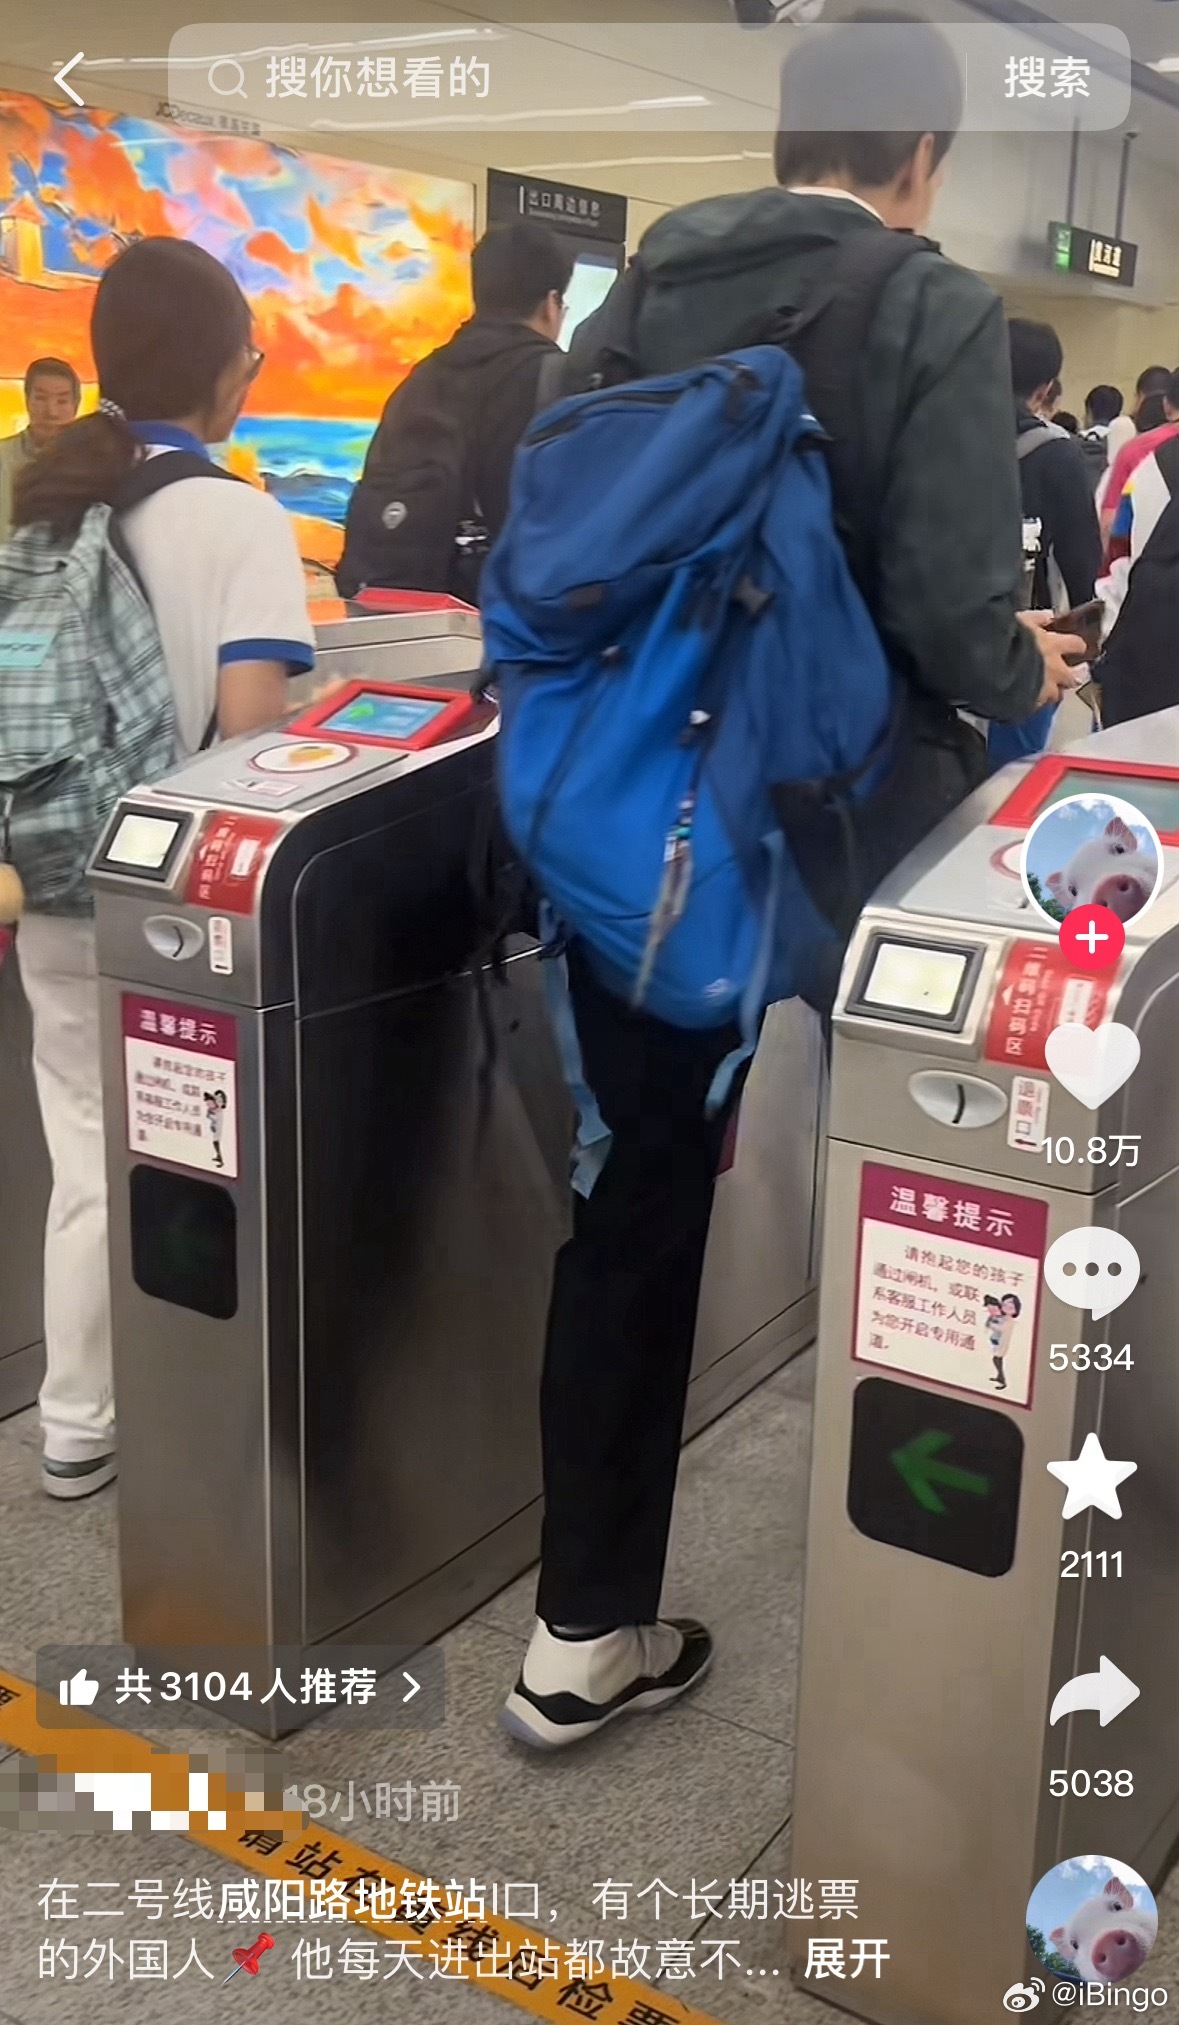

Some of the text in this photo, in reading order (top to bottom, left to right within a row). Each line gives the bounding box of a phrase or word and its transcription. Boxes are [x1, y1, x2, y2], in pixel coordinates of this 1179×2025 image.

[139, 1009, 217, 1045] 温馨提示
[889, 1185, 1015, 1237] 温馨提示
[904, 1244, 1024, 1287] 请抱起您的孩子
